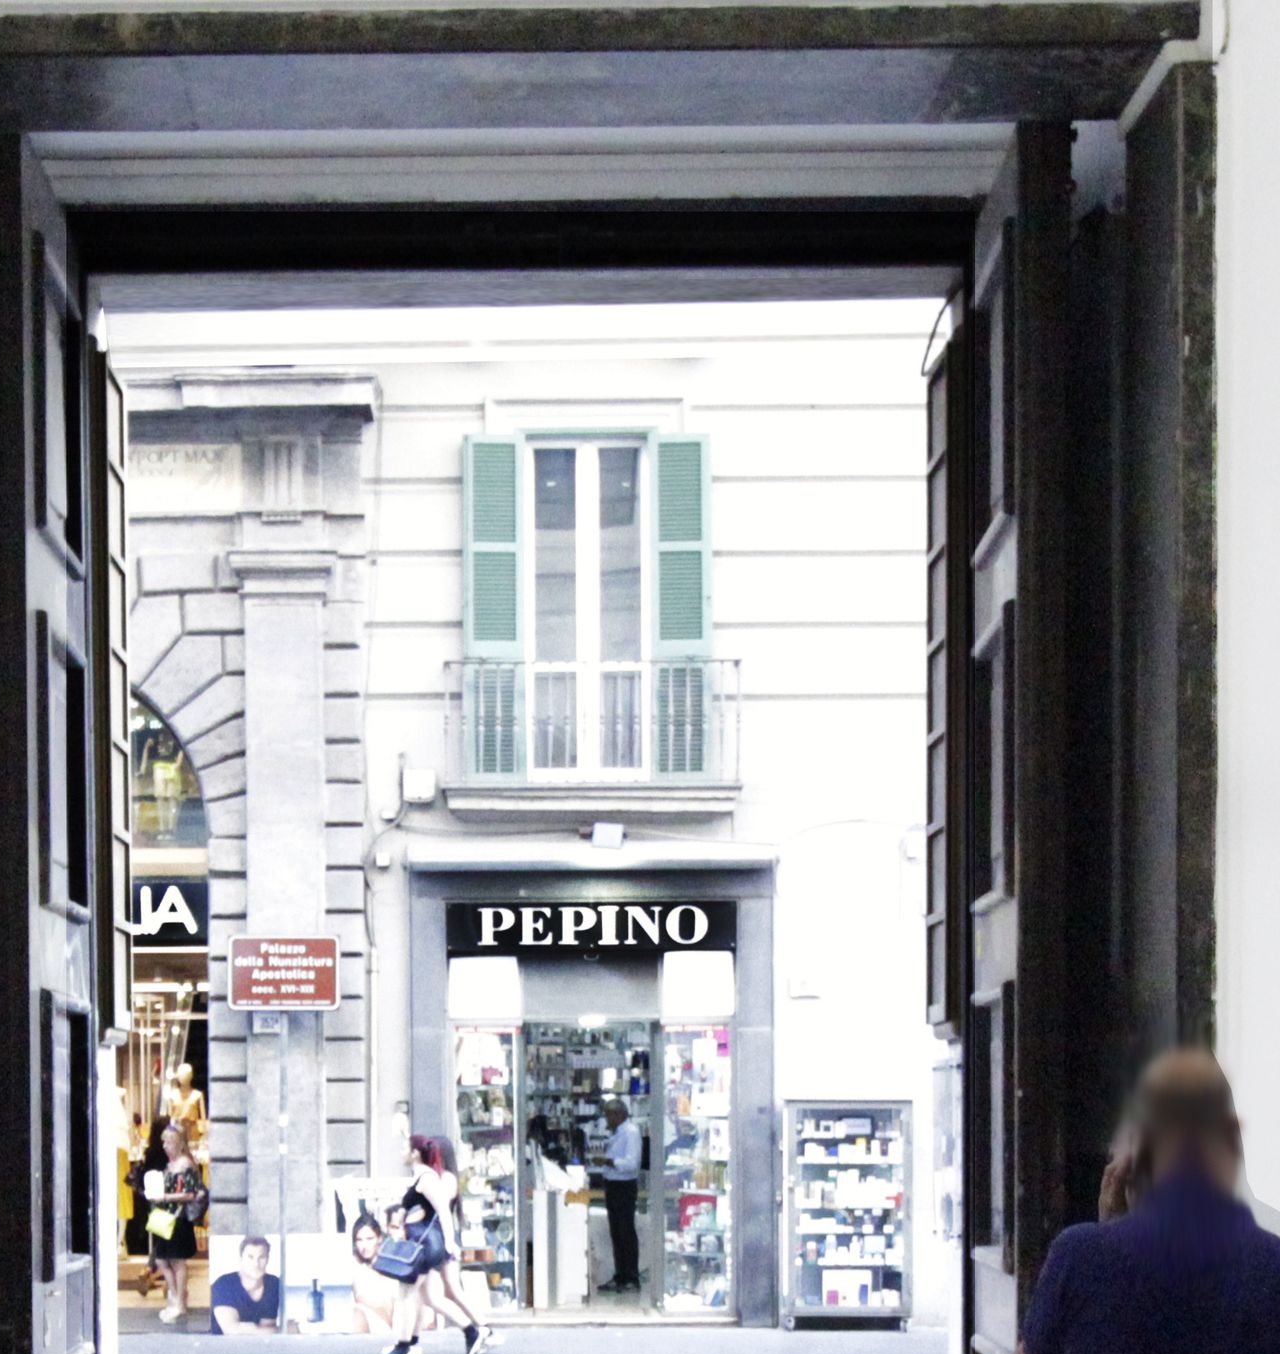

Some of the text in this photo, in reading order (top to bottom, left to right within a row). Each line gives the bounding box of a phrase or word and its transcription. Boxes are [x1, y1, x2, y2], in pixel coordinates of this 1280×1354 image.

[477, 905, 709, 946] PEPINO
[260, 943, 307, 955] Palazzo
[234, 956, 334, 967] della Nunziatura
[252, 968, 316, 981] Apostolica
